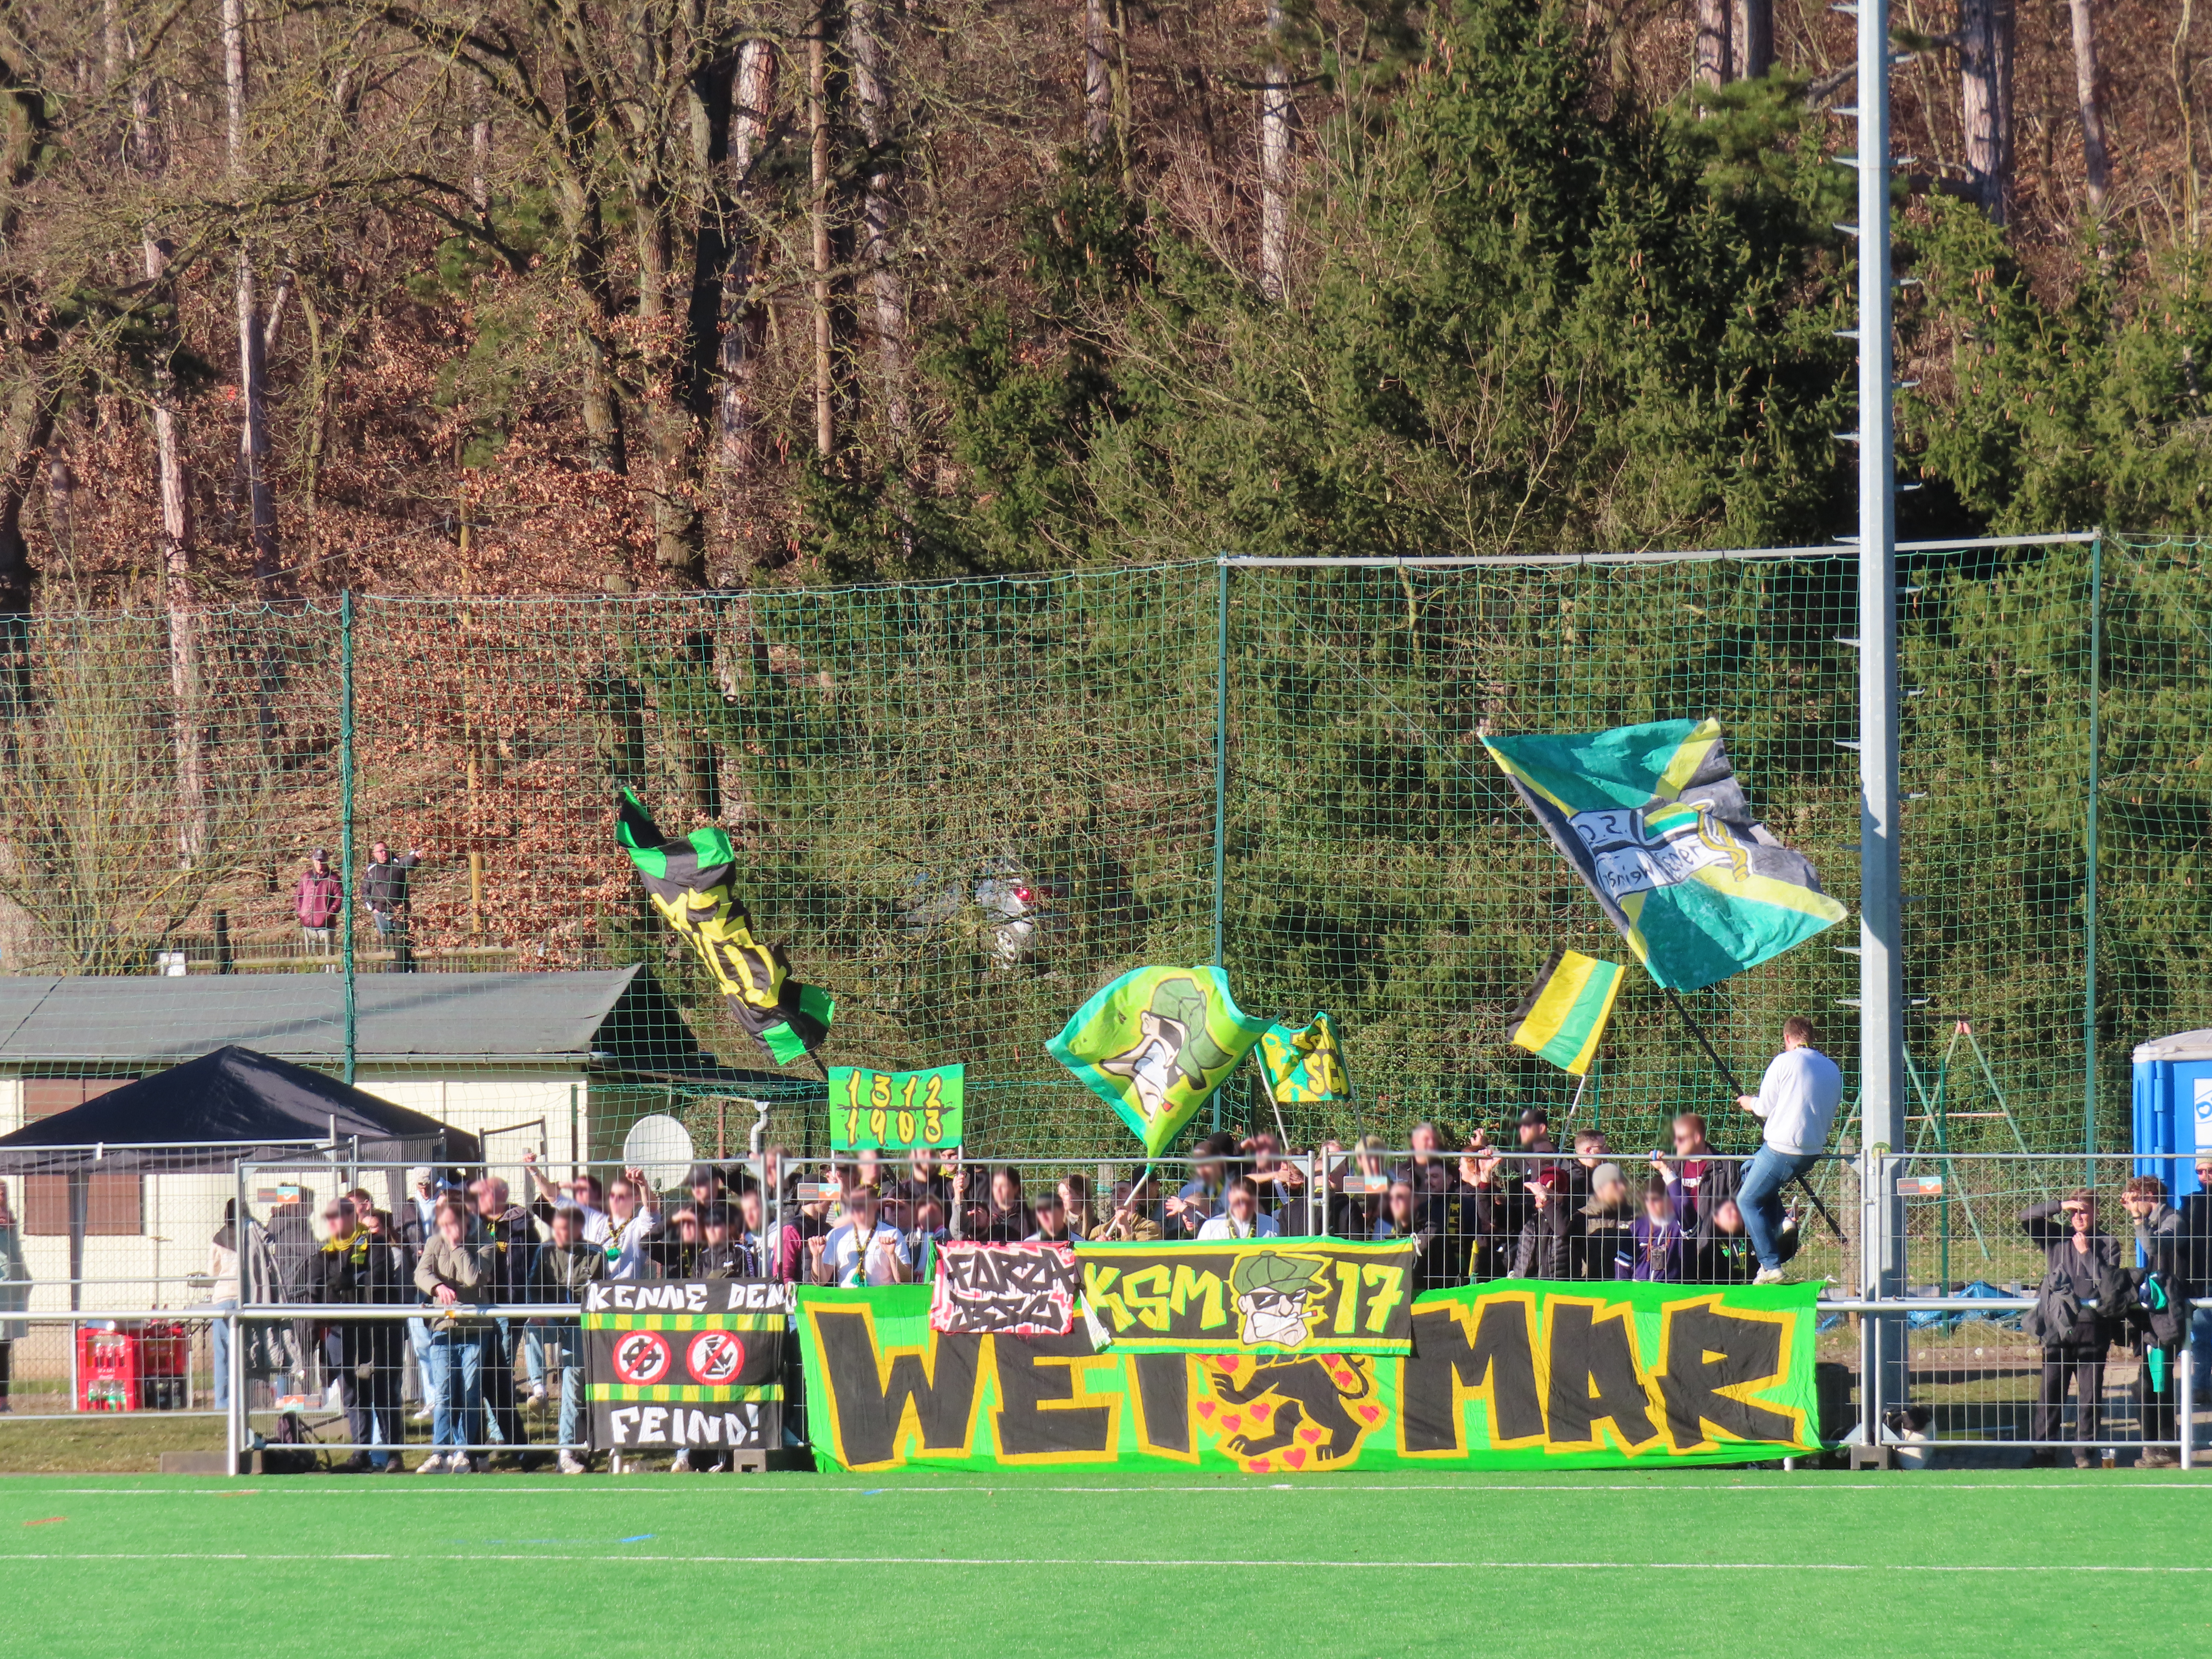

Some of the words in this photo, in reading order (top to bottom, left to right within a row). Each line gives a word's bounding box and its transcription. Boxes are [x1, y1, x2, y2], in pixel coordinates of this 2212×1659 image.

[846, 1069, 943, 1108] 1312
[845, 1108, 943, 1148] 1903
[585, 1283, 707, 1312] KENNE
[728, 1283, 786, 1310] DEN
[1084, 1262, 1227, 1333] KSM
[1333, 1260, 1404, 1334] 17
[611, 1403, 759, 1446] FEIND!
